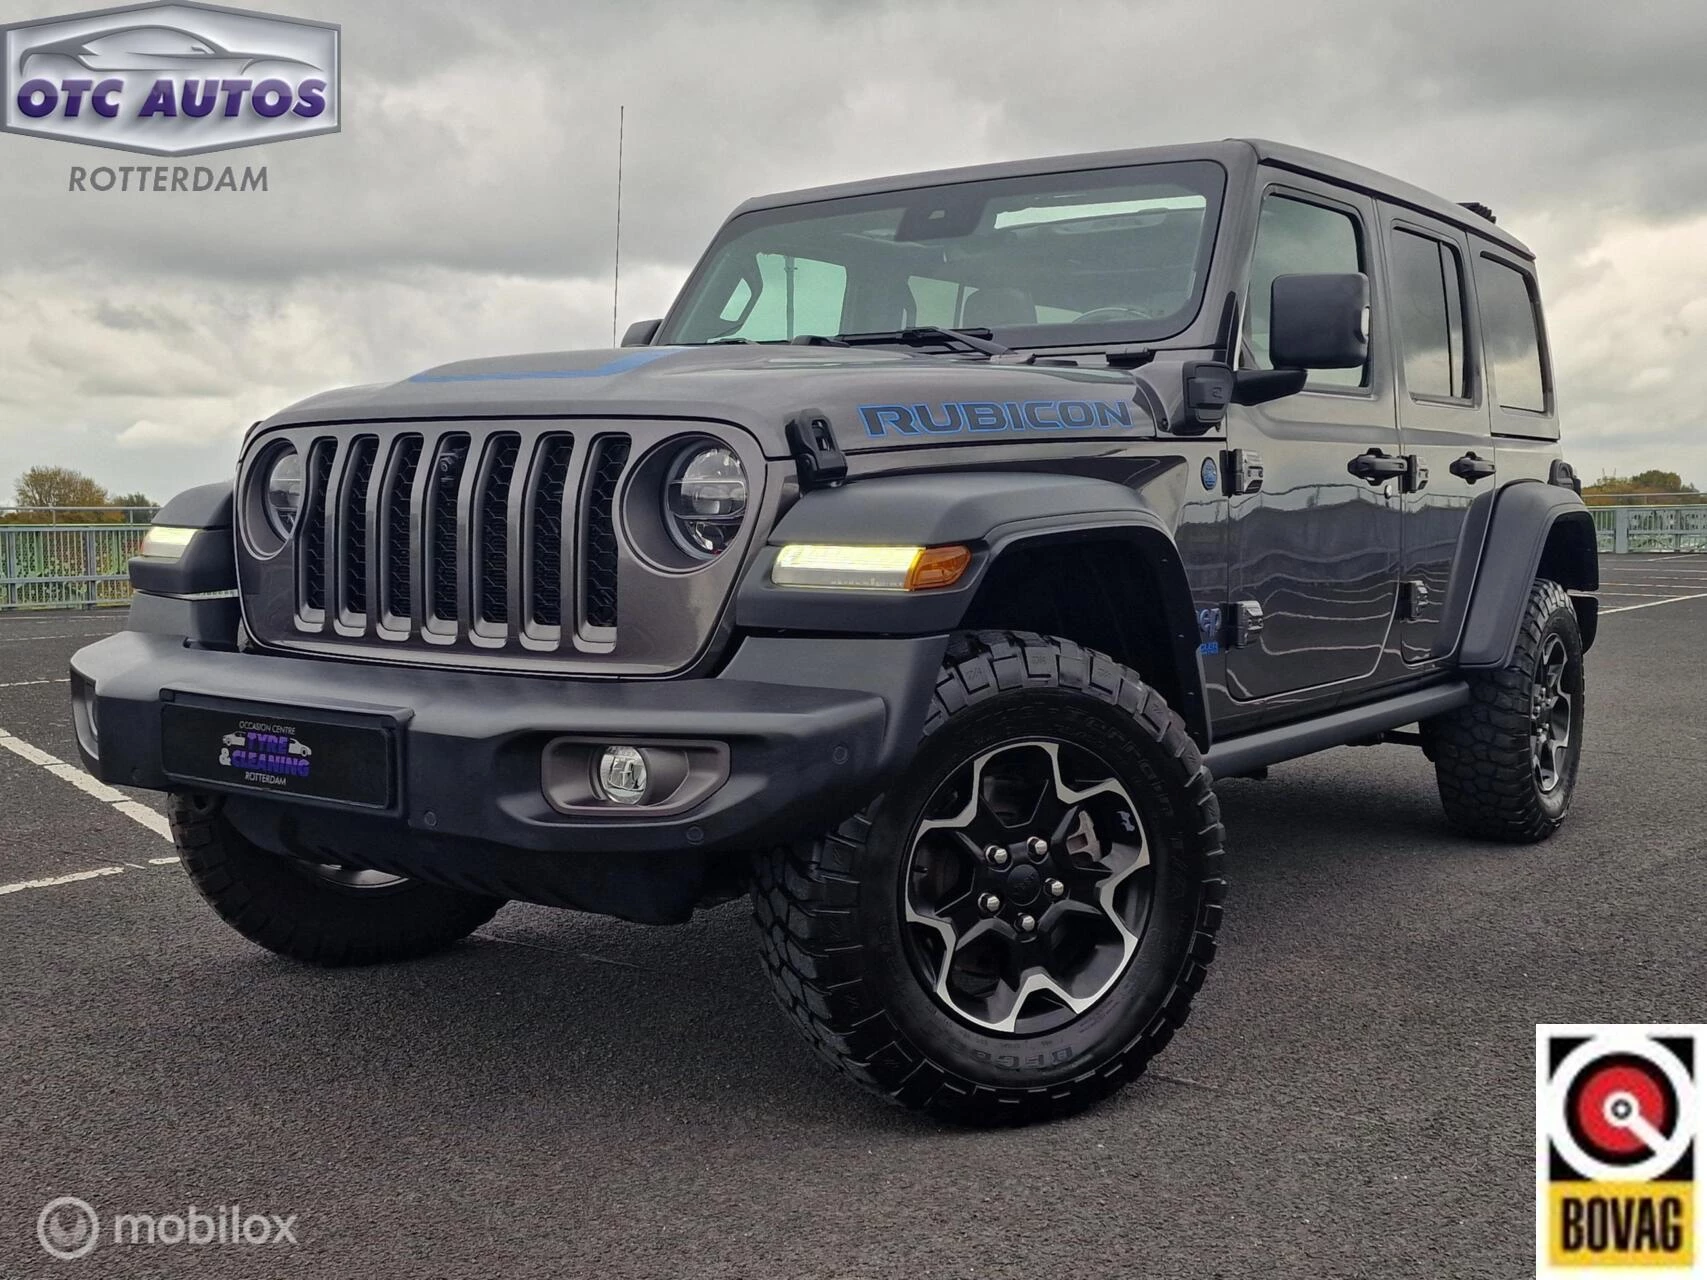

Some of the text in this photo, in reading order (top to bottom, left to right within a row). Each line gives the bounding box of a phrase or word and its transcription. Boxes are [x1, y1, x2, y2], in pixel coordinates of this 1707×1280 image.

[858, 400, 1134, 438] RUBICON
[239, 721, 296, 735] OCCASION CENTRE
[247, 732, 288, 754] TYRE
[231, 750, 310, 776] CLEANING
[245, 771, 287, 784] ROTTERDAM
